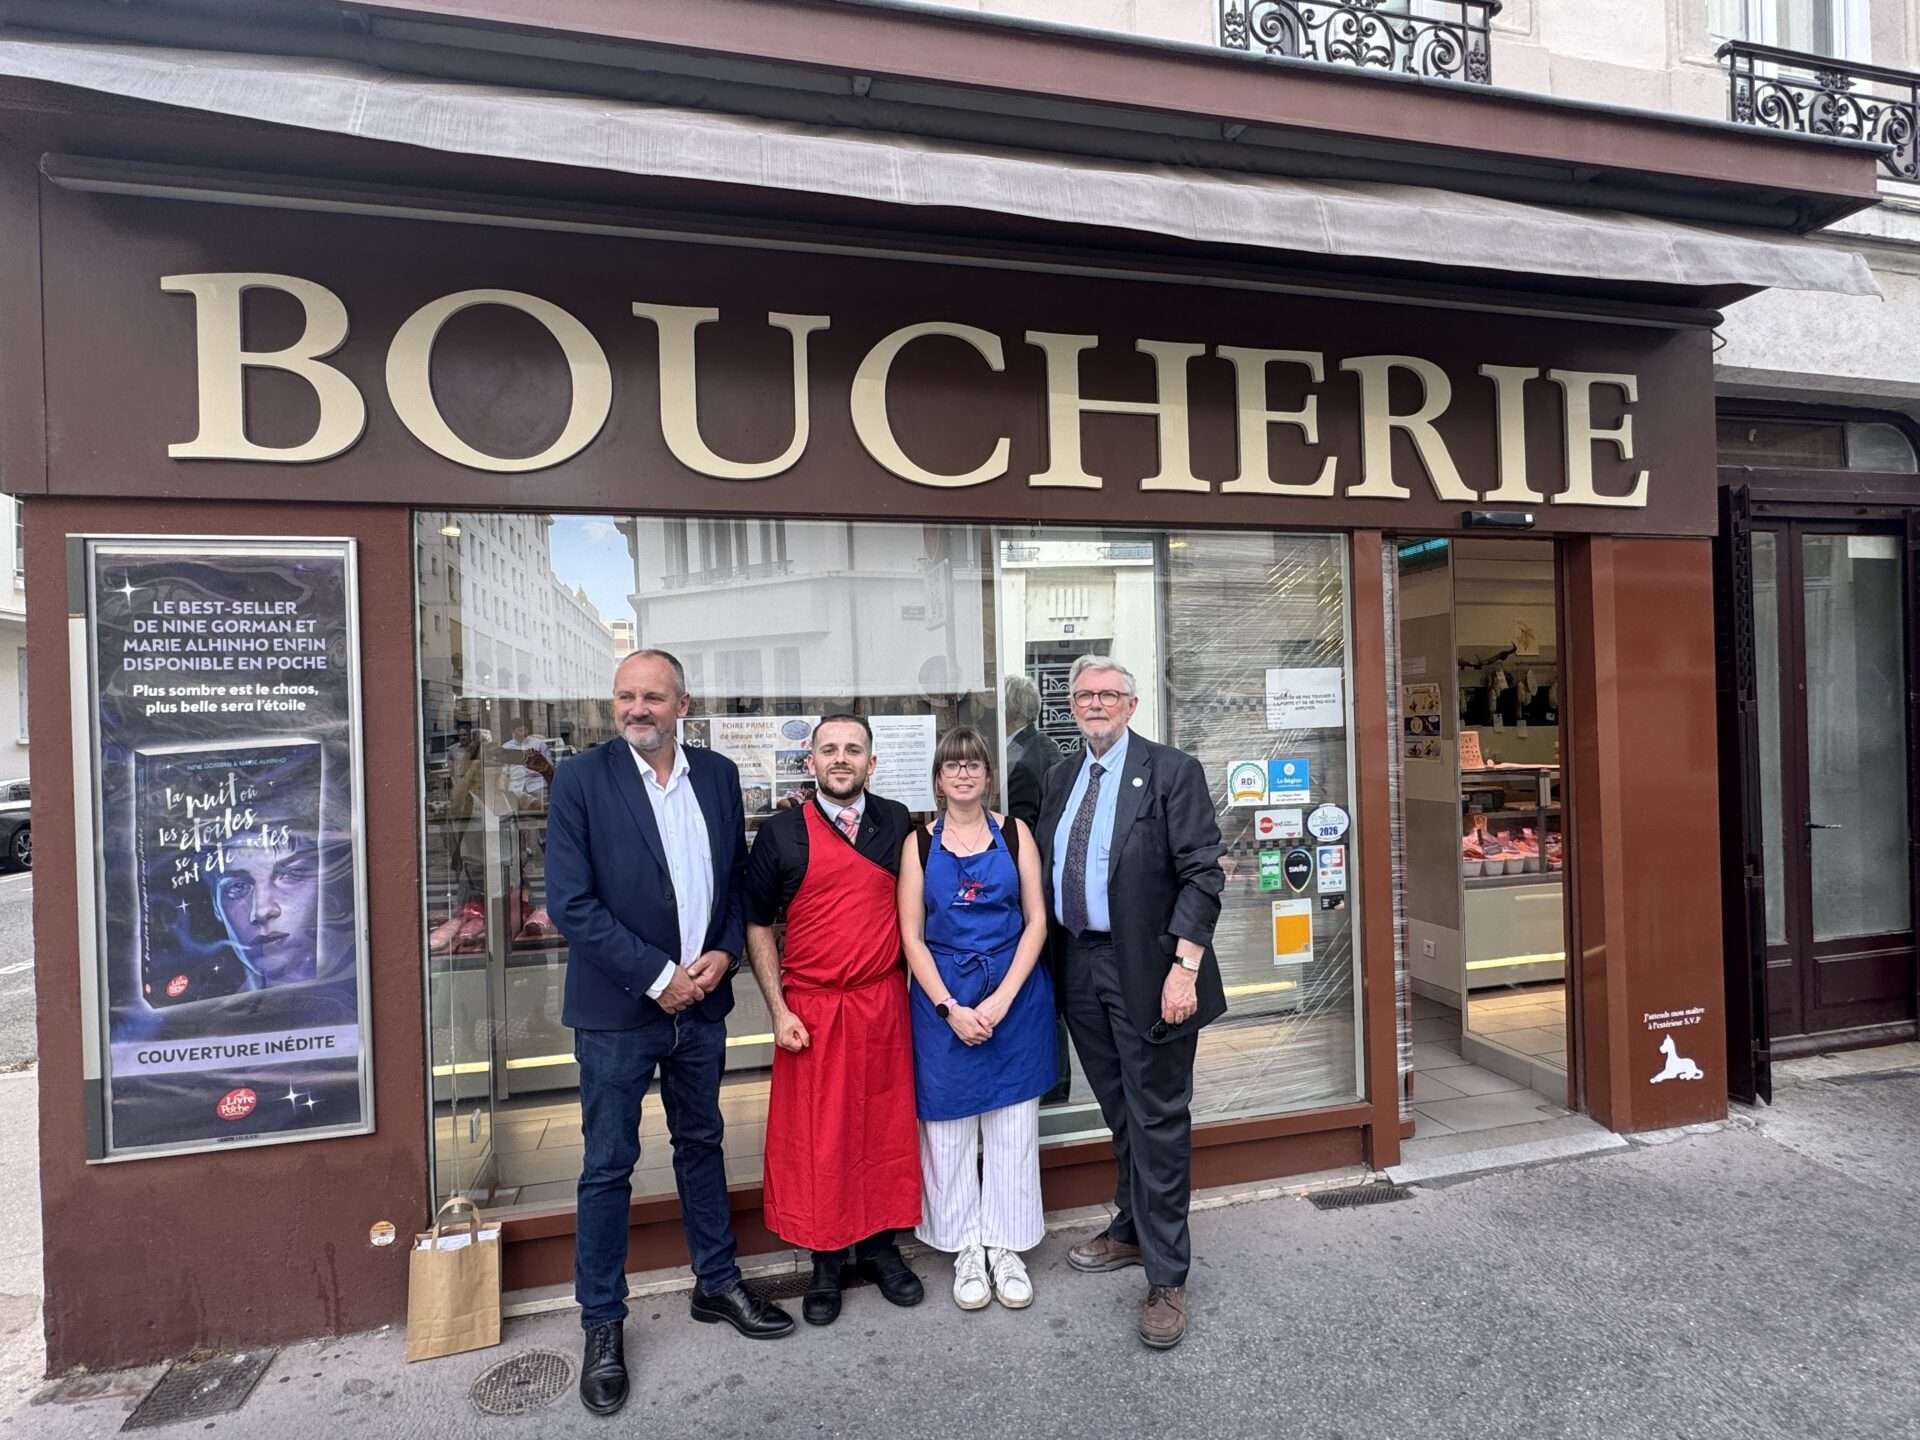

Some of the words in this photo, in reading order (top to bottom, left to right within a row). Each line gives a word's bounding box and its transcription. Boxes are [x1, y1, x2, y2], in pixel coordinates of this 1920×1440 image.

[160, 272, 1650, 508] BOUCHERIE
[153, 601, 175, 615] LE
[179, 601, 298, 615] BEST-SELLER
[133, 620, 158, 633] DE
[163, 620, 207, 633] NINE
[211, 619, 291, 633] GORMAN
[296, 619, 317, 633] ET
[123, 638, 181, 652] MARIE
[185, 638, 269, 652] ALHINHO
[274, 637, 326, 651] ENFIN
[123, 656, 234, 671] DISPONIBLE
[239, 656, 263, 670] EN
[266, 656, 328, 670] POCHE
[133, 684, 166, 697] Plus
[168, 684, 226, 697] sombre
[229, 685, 253, 696] est
[255, 683, 269, 696] le
[272, 683, 319, 698] chaos,
[146, 700, 177, 716] plus
[180, 699, 218, 713] belle
[220, 701, 255, 713] sera
[165, 787, 185, 810] La
[186, 772, 238, 819] nuit
[159, 828, 178, 847] les
[180, 808, 258, 853] étoiles
[1319, 825, 1339, 837] 2026
[175, 857, 191, 872] se
[171, 862, 200, 889] sont
[137, 1042, 260, 1065] COUVERTURE
[265, 1035, 336, 1056] INÉDITE
